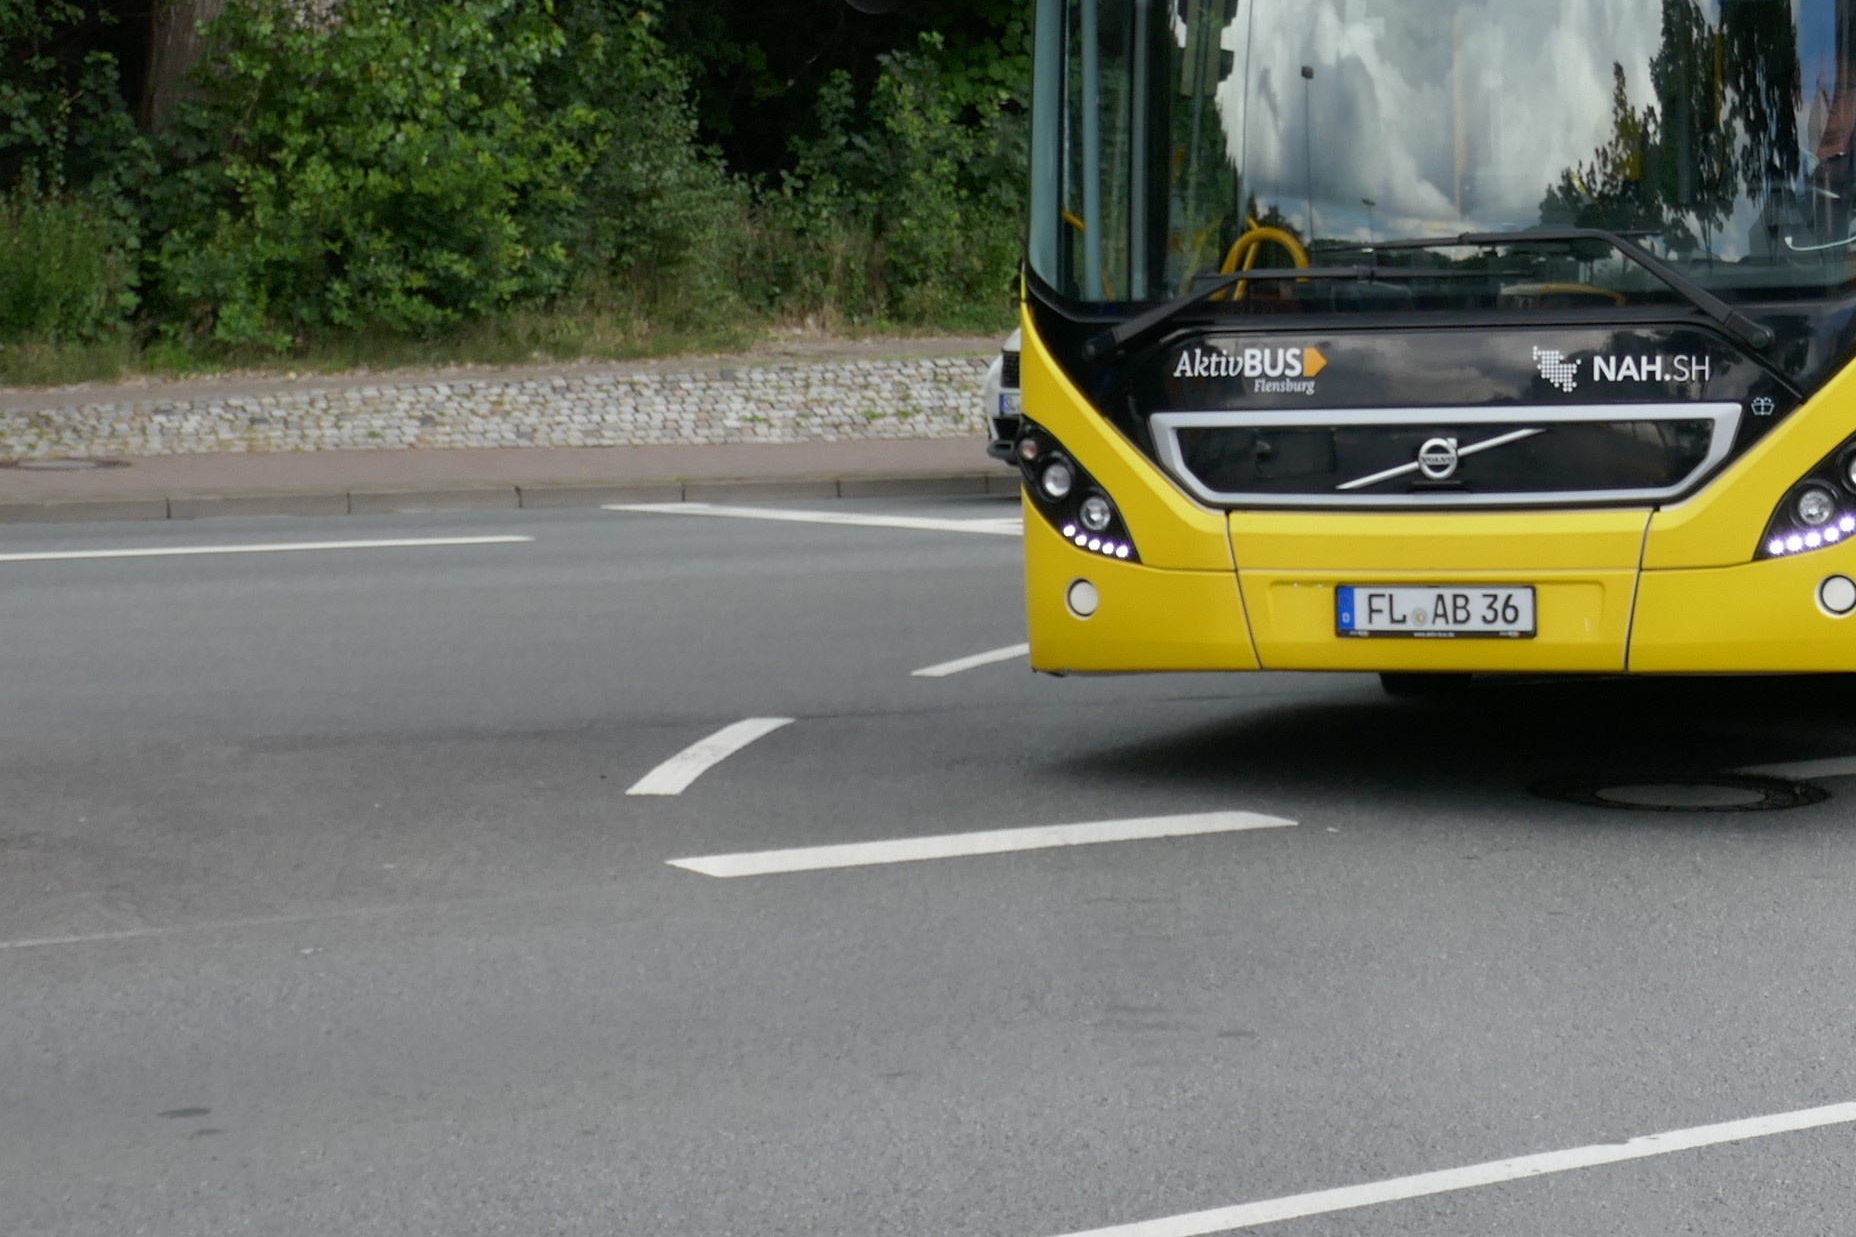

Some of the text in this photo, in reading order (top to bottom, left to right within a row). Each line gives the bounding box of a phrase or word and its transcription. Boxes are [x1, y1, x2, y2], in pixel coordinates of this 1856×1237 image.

[1173, 347, 1302, 378] AktivBUS
[1593, 355, 1709, 381] NAH.SH
[1254, 379, 1316, 395] Flensburg
[1368, 593, 1407, 625] FL
[1432, 593, 1471, 625] AB
[1481, 593, 1519, 625] 36
